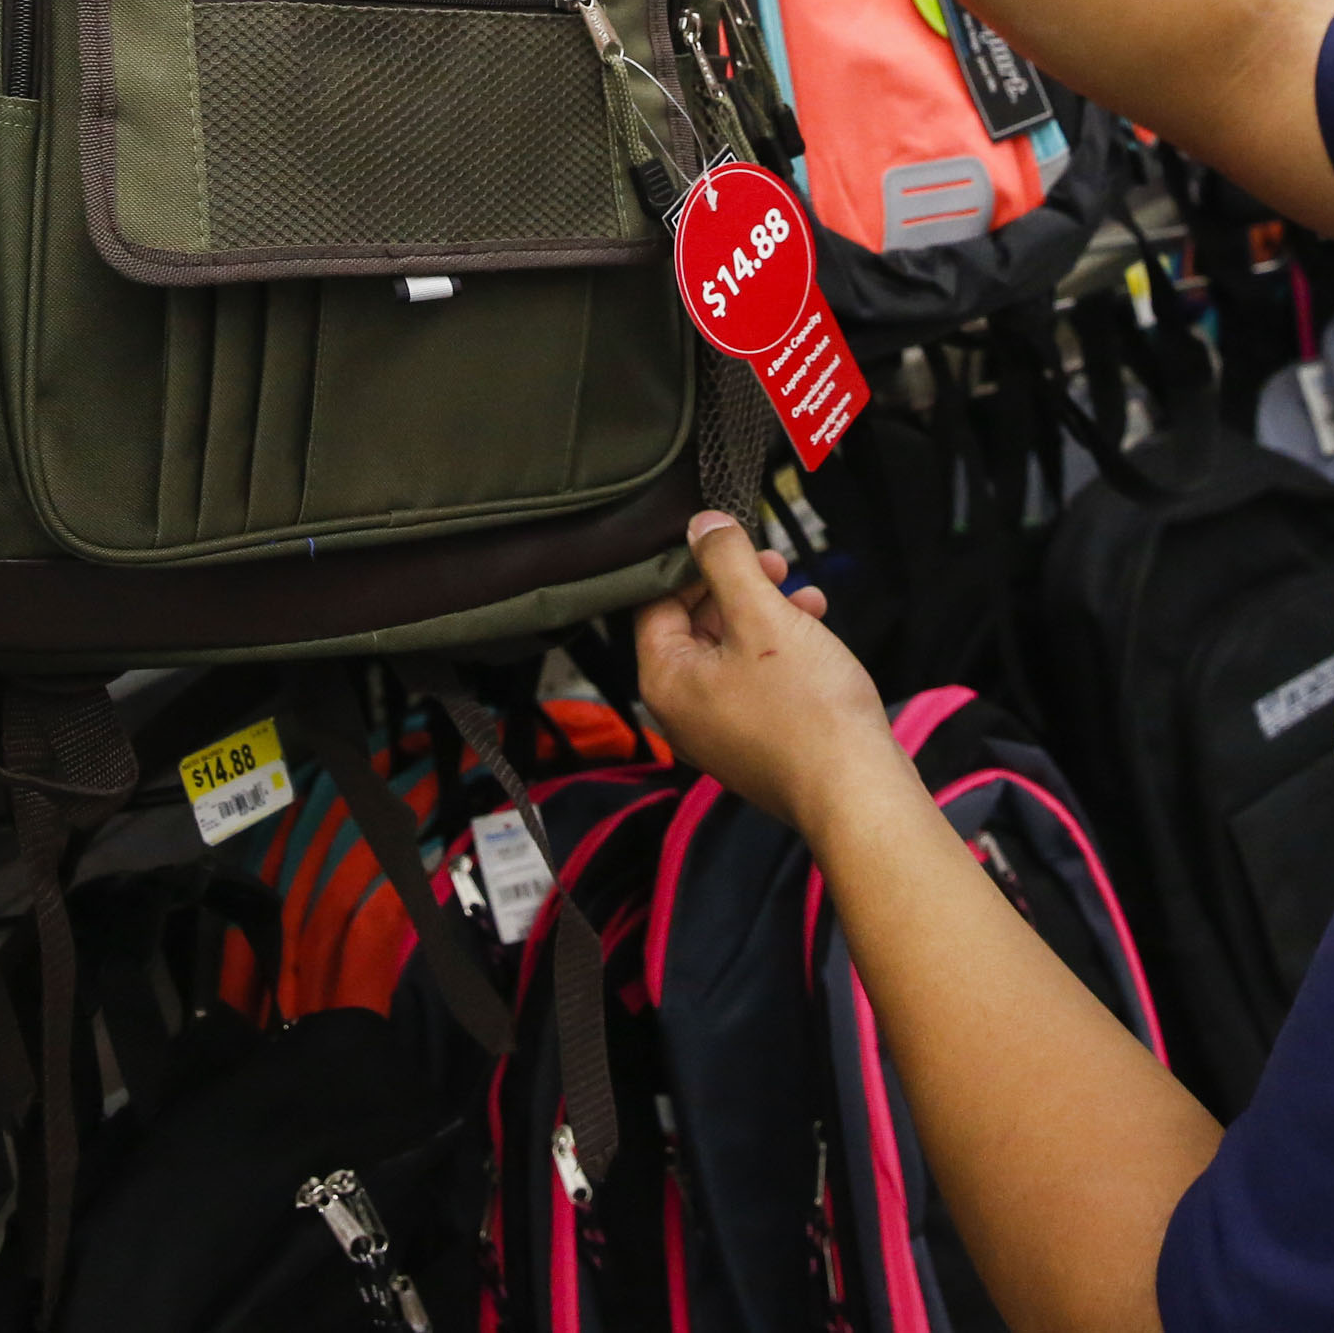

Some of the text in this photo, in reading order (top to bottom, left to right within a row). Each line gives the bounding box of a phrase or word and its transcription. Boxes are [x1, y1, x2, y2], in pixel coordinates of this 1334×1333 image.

[702, 207, 790, 318] $14.88
[767, 311, 822, 377] 4 Book Capacity
[781, 335, 830, 396] Laptop Pocket
[791, 354, 842, 418] Organizational
[808, 381, 836, 415] Pockets
[809, 392, 852, 446] Smartphone
[192, 744, 256, 788] $14.88
